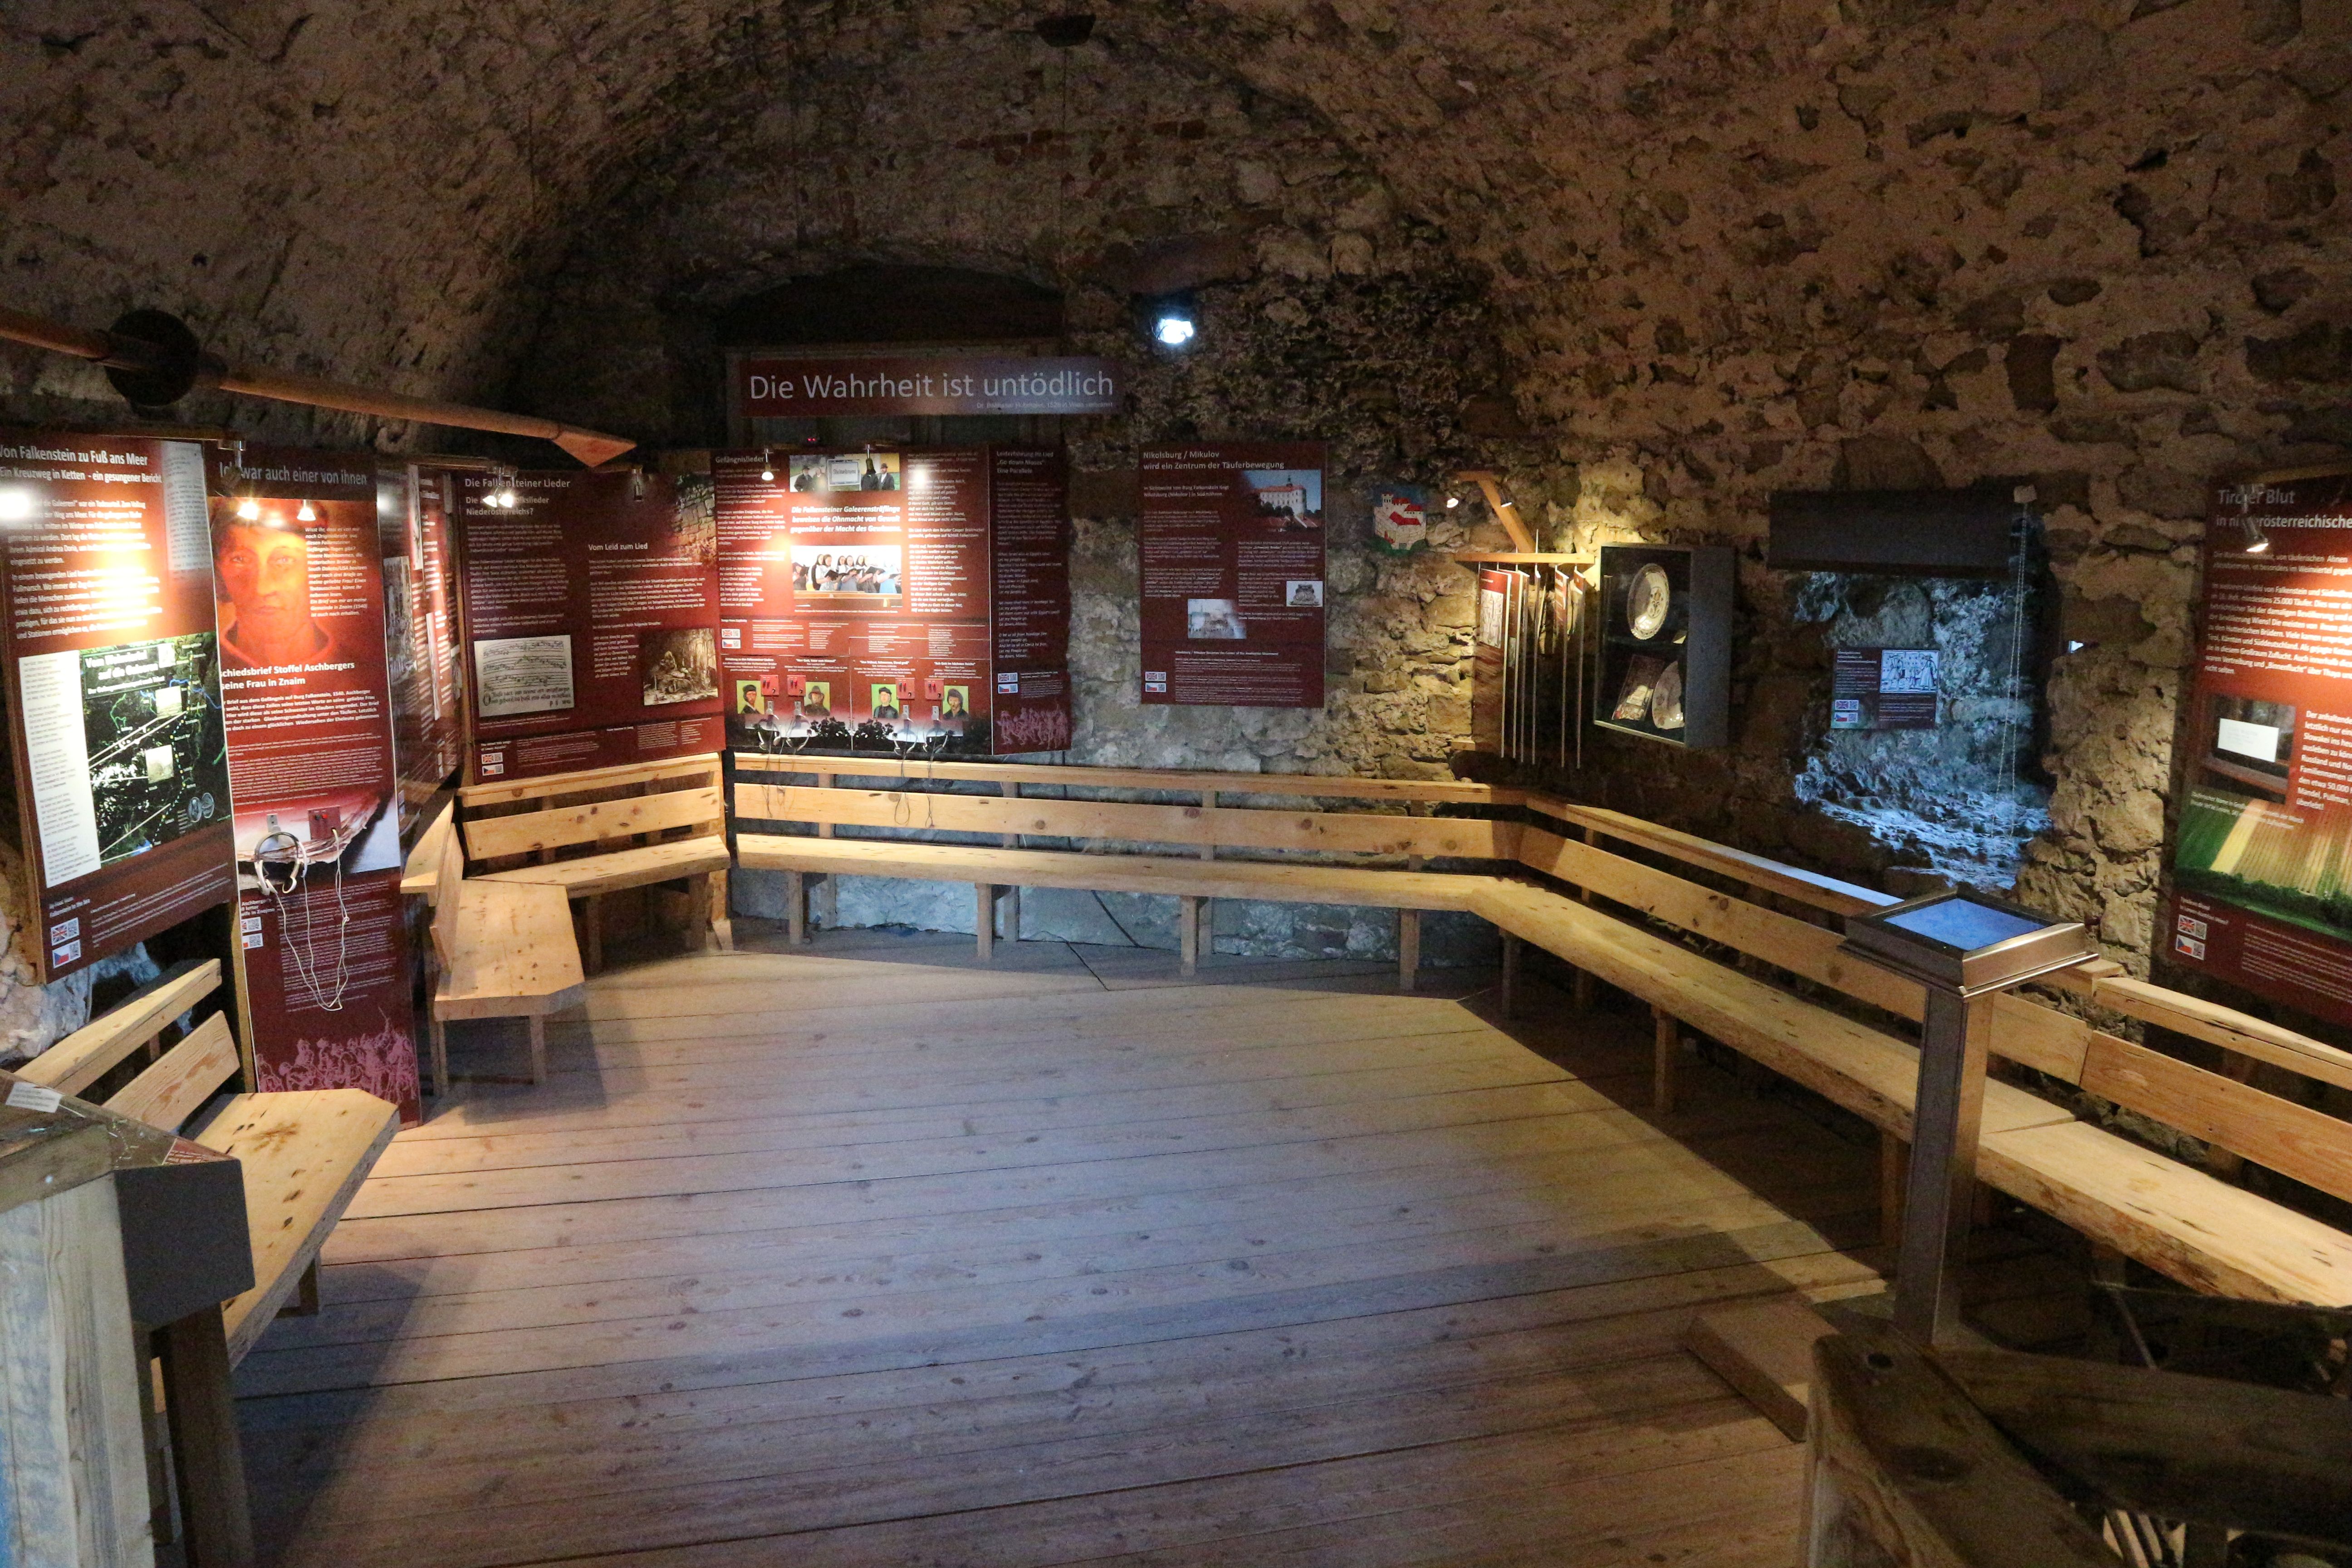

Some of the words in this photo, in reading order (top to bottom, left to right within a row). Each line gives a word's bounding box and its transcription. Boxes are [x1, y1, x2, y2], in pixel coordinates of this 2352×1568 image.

[750, 376, 794, 399] Die
[803, 373, 933, 399] Wahrheit
[942, 373, 974, 397] ist
[983, 371, 1113, 398] untödlich
[20, 446, 76, 461] Falkenstein
[78, 453, 89, 462] zu
[90, 451, 107, 463] Fuß
[110, 455, 125, 464] ans
[126, 453, 147, 465] Meer
[1183, 451, 1188, 459] /
[1222, 462, 1284, 470] Täuferbewegung
[14, 468, 52, 480] Kreuzweg
[52, 469, 60, 479] in
[61, 470, 86, 480] Ketten
[93, 471, 103, 480] ein
[104, 474, 141, 483] gesungener
[141, 473, 162, 483] Bericht
[241, 465, 262, 480] war
[265, 466, 290, 481] auch
[293, 467, 318, 482] einer
[320, 472, 339, 484] von
[341, 470, 367, 485] ihnen
[544, 479, 571, 487] Lieder
[2266, 489, 2296, 504] Blut
[466, 507, 534, 515] Niederösterreichs?
[803, 505, 843, 514] Falkensteiner
[843, 505, 901, 514] Galeerensträflinge
[85, 658, 104, 668] Vom
[273, 665, 302, 673] Stoffel
[304, 663, 355, 671] Aschbergers
[220, 680, 245, 691] seine
[278, 677, 305, 686] Znaim
